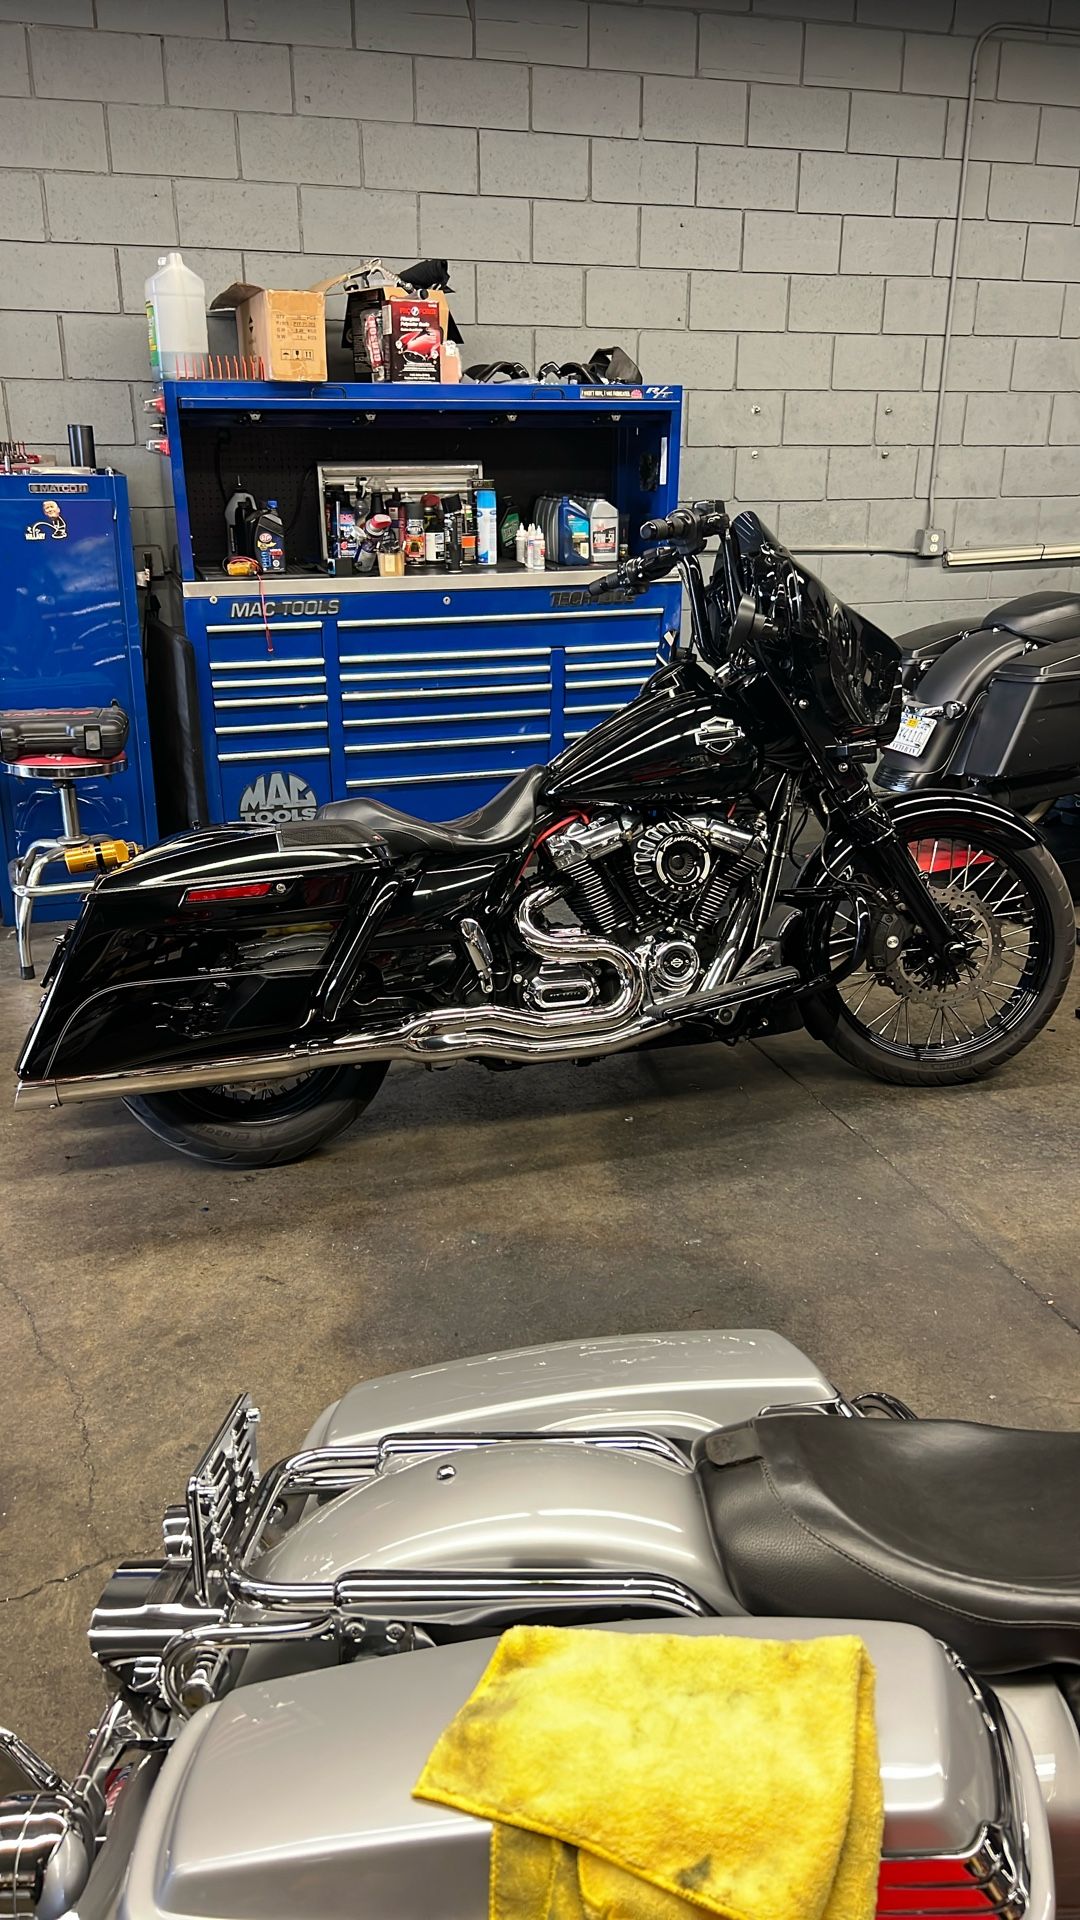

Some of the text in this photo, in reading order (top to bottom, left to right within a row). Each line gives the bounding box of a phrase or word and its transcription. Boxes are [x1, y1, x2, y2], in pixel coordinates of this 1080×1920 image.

[367, 318, 382, 362] GERSON
[231, 600, 339, 617] MAC TOOLS
[240, 773, 317, 812] MAC
[240, 808, 317, 823] TOOLS
